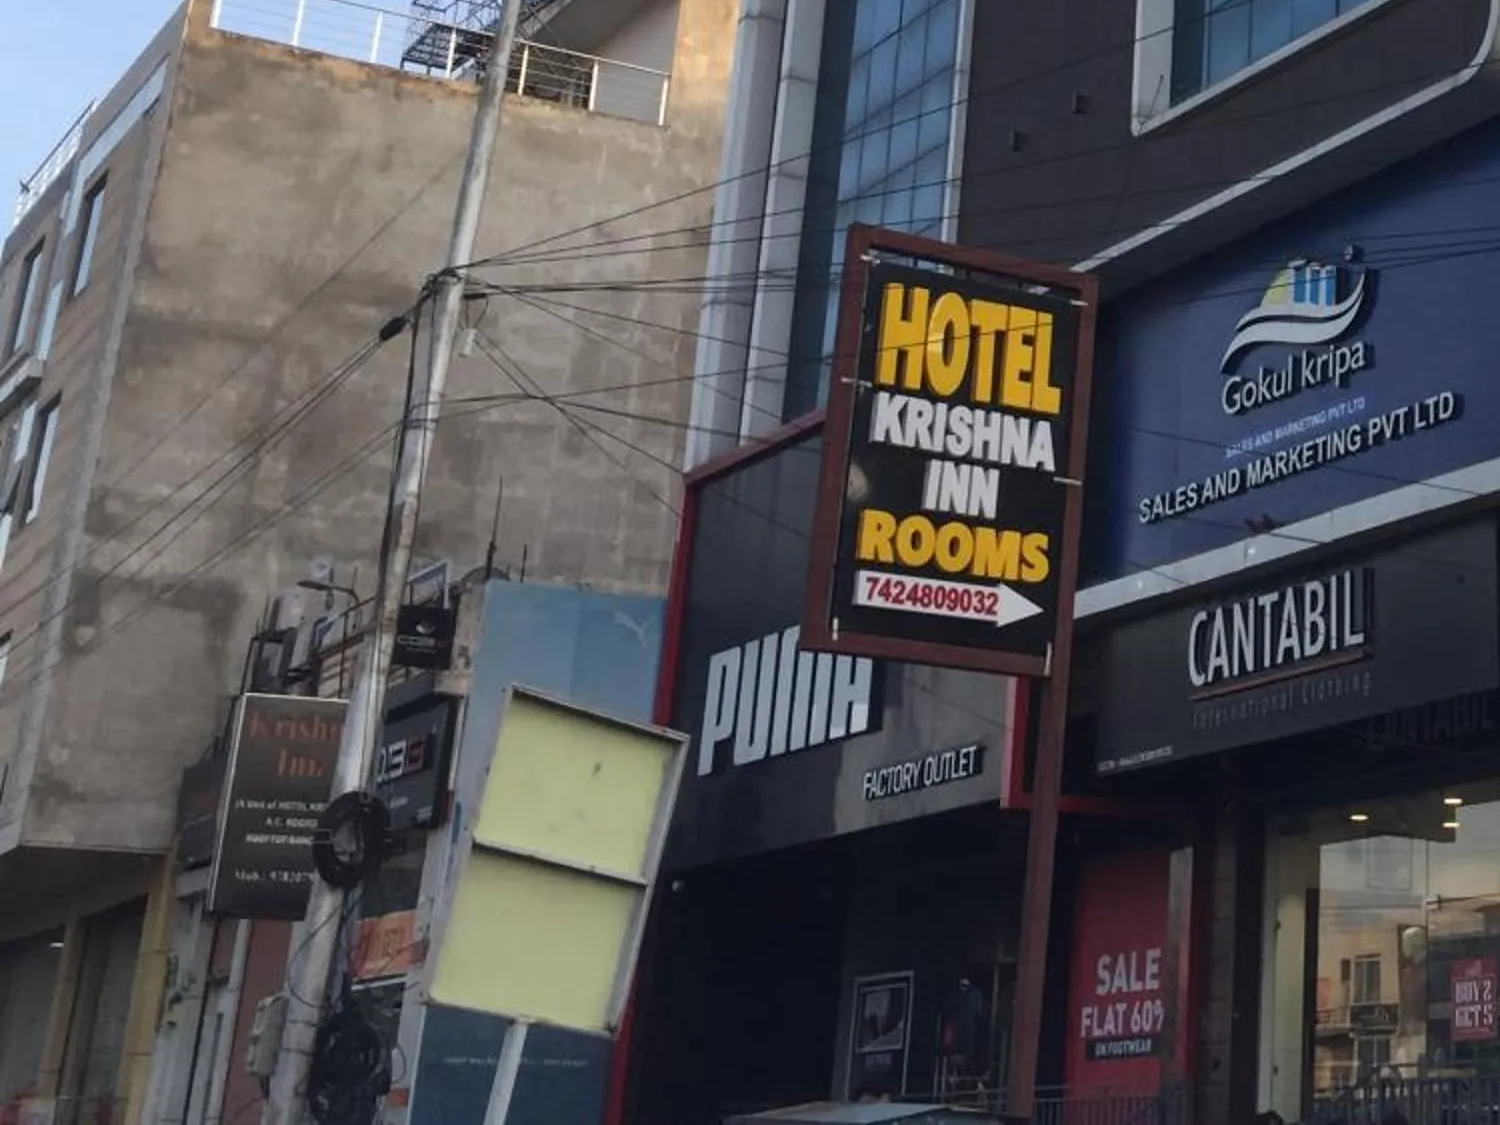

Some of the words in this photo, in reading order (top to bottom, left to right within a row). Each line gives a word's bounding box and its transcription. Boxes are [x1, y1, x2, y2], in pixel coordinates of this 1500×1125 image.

[877, 282, 1062, 414] HOTEL
[1221, 354, 1292, 414] Gokul
[1301, 340, 1366, 389] kripa
[870, 391, 1056, 472] KRISHNA
[1139, 481, 1198, 524] SALES
[1200, 468, 1240, 504] AND
[1246, 424, 1361, 488] MARKETING
[1368, 405, 1408, 445] PVT
[1413, 390, 1455, 429] LTD
[922, 459, 999, 520] INN
[856, 508, 1050, 582] ROOMS
[866, 576, 999, 617] 7424809032
[1188, 569, 1365, 687] CANTABIL
[697, 625, 873, 776] PUMA
[863, 757, 922, 800] FACTORY
[924, 745, 978, 787] OUTLET
[1096, 947, 1161, 996] SALE
[1080, 1003, 1127, 1038] FLAT
